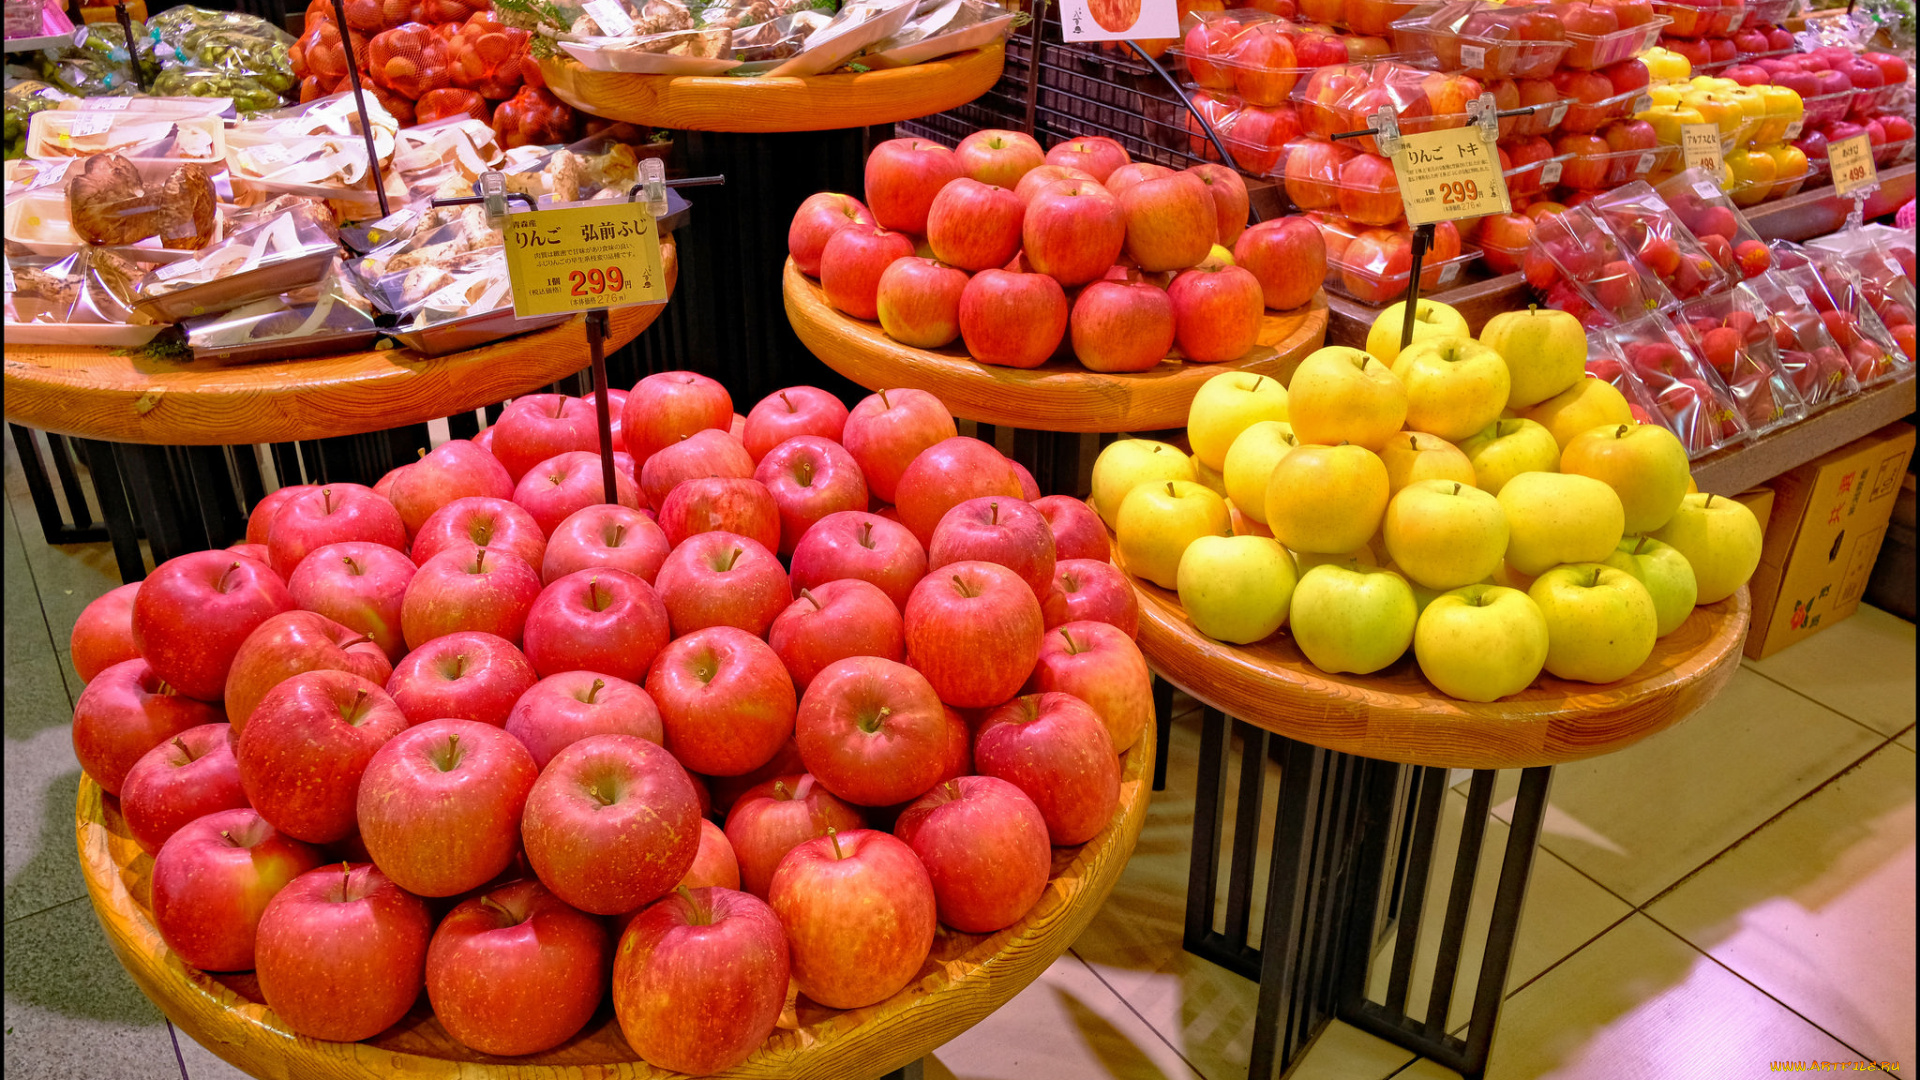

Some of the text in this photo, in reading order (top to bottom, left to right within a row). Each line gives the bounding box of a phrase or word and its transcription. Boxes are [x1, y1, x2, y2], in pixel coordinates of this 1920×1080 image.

[1408, 142, 1479, 165] りんご トキ
[1849, 165, 1865, 182] 499
[516, 218, 648, 249] りんご 弘前ふじ
